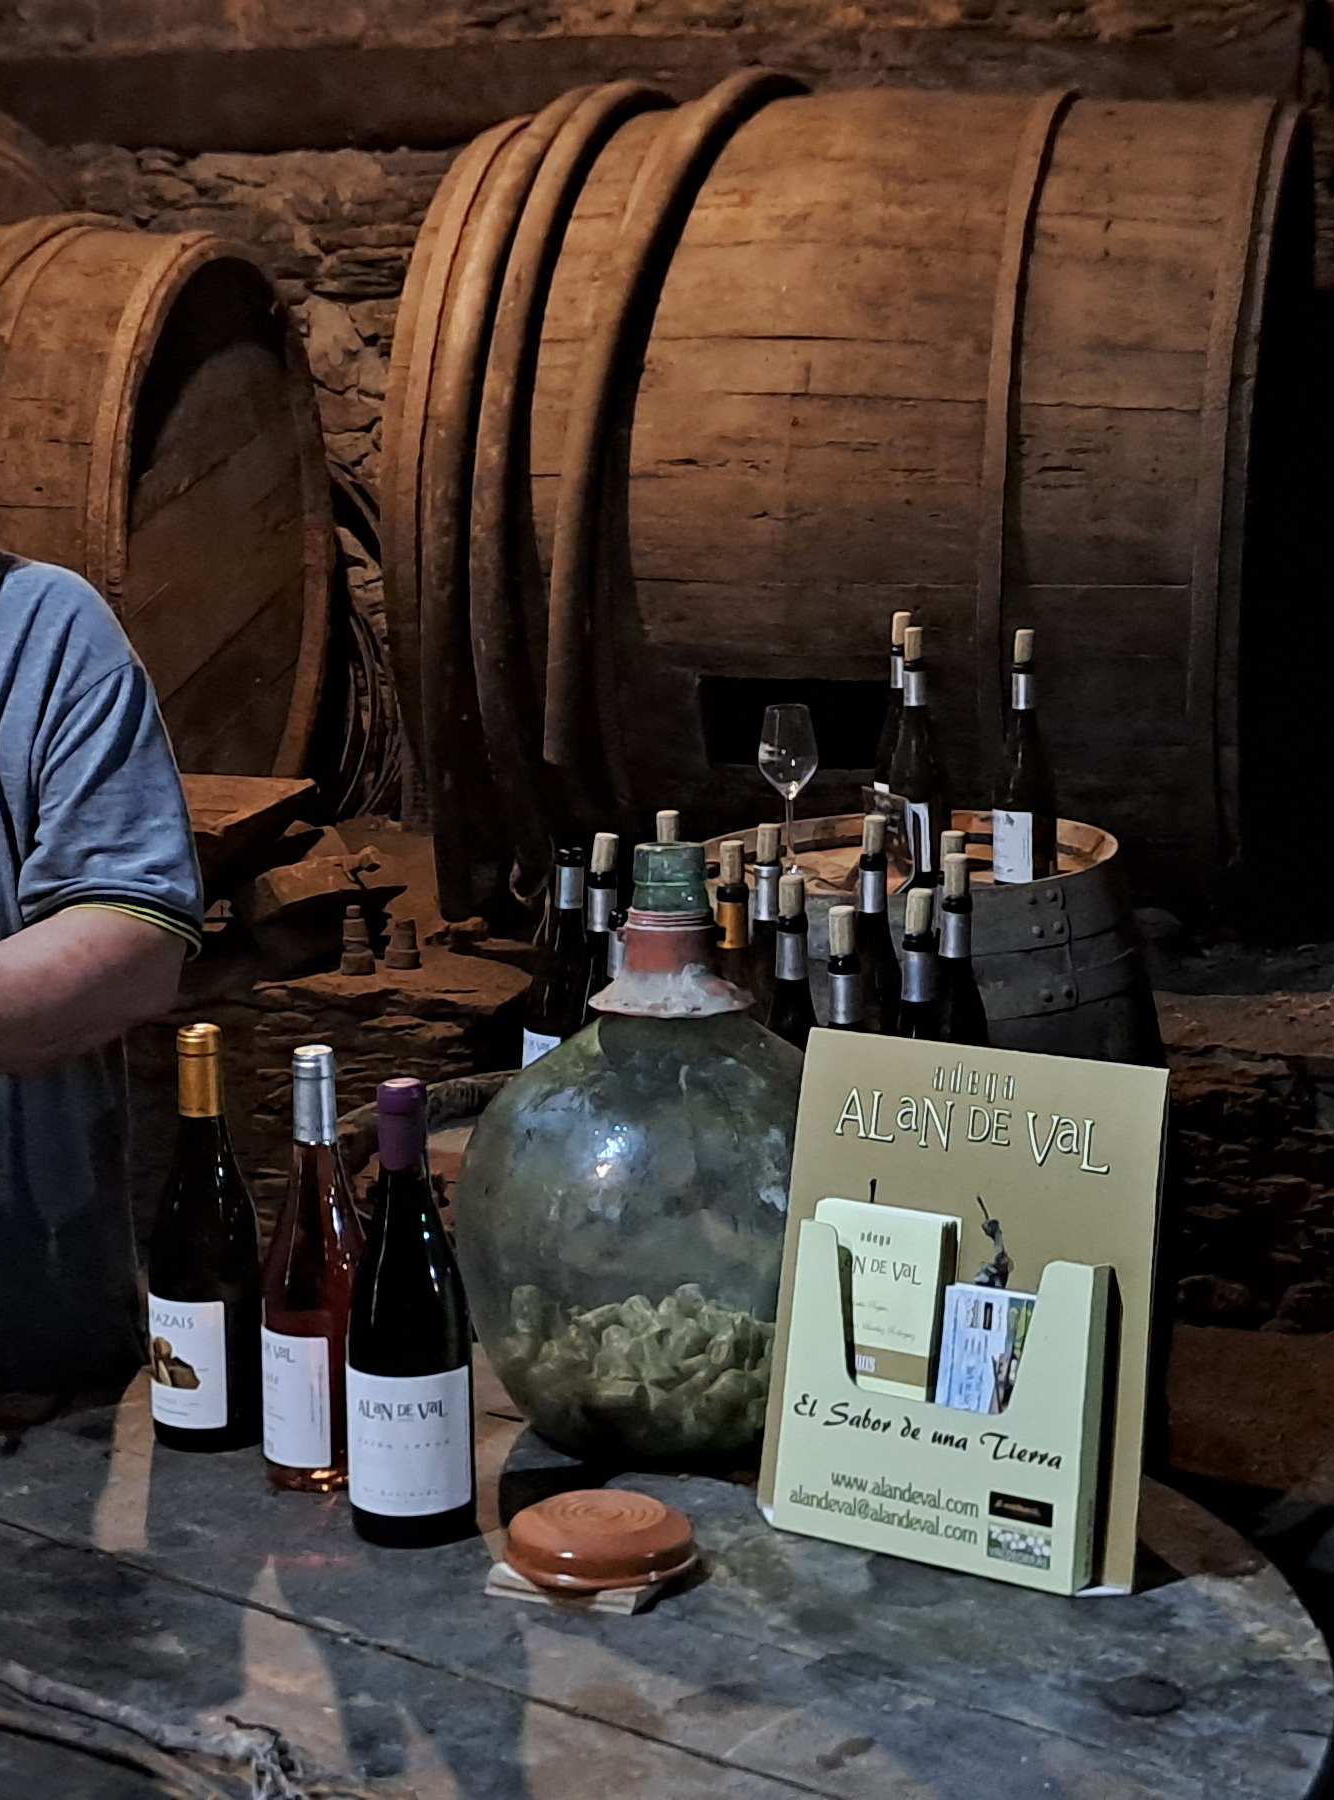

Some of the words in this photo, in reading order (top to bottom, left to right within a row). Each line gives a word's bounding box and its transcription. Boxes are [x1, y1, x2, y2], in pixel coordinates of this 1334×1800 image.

[932, 1061, 1017, 1103] adega
[966, 1104, 1012, 1147] DE
[870, 1258, 888, 1275] DE
[397, 1403, 414, 1417] DE
[793, 1393, 818, 1418] El
[822, 1402, 892, 1434] Sabor
[900, 1415, 921, 1441] de
[931, 1430, 969, 1451] una
[978, 1431, 1063, 1470] Tierra
[789, 1484, 978, 1546] alandeval@alandeval.com
[830, 1470, 979, 1519] www.alandeval.com
